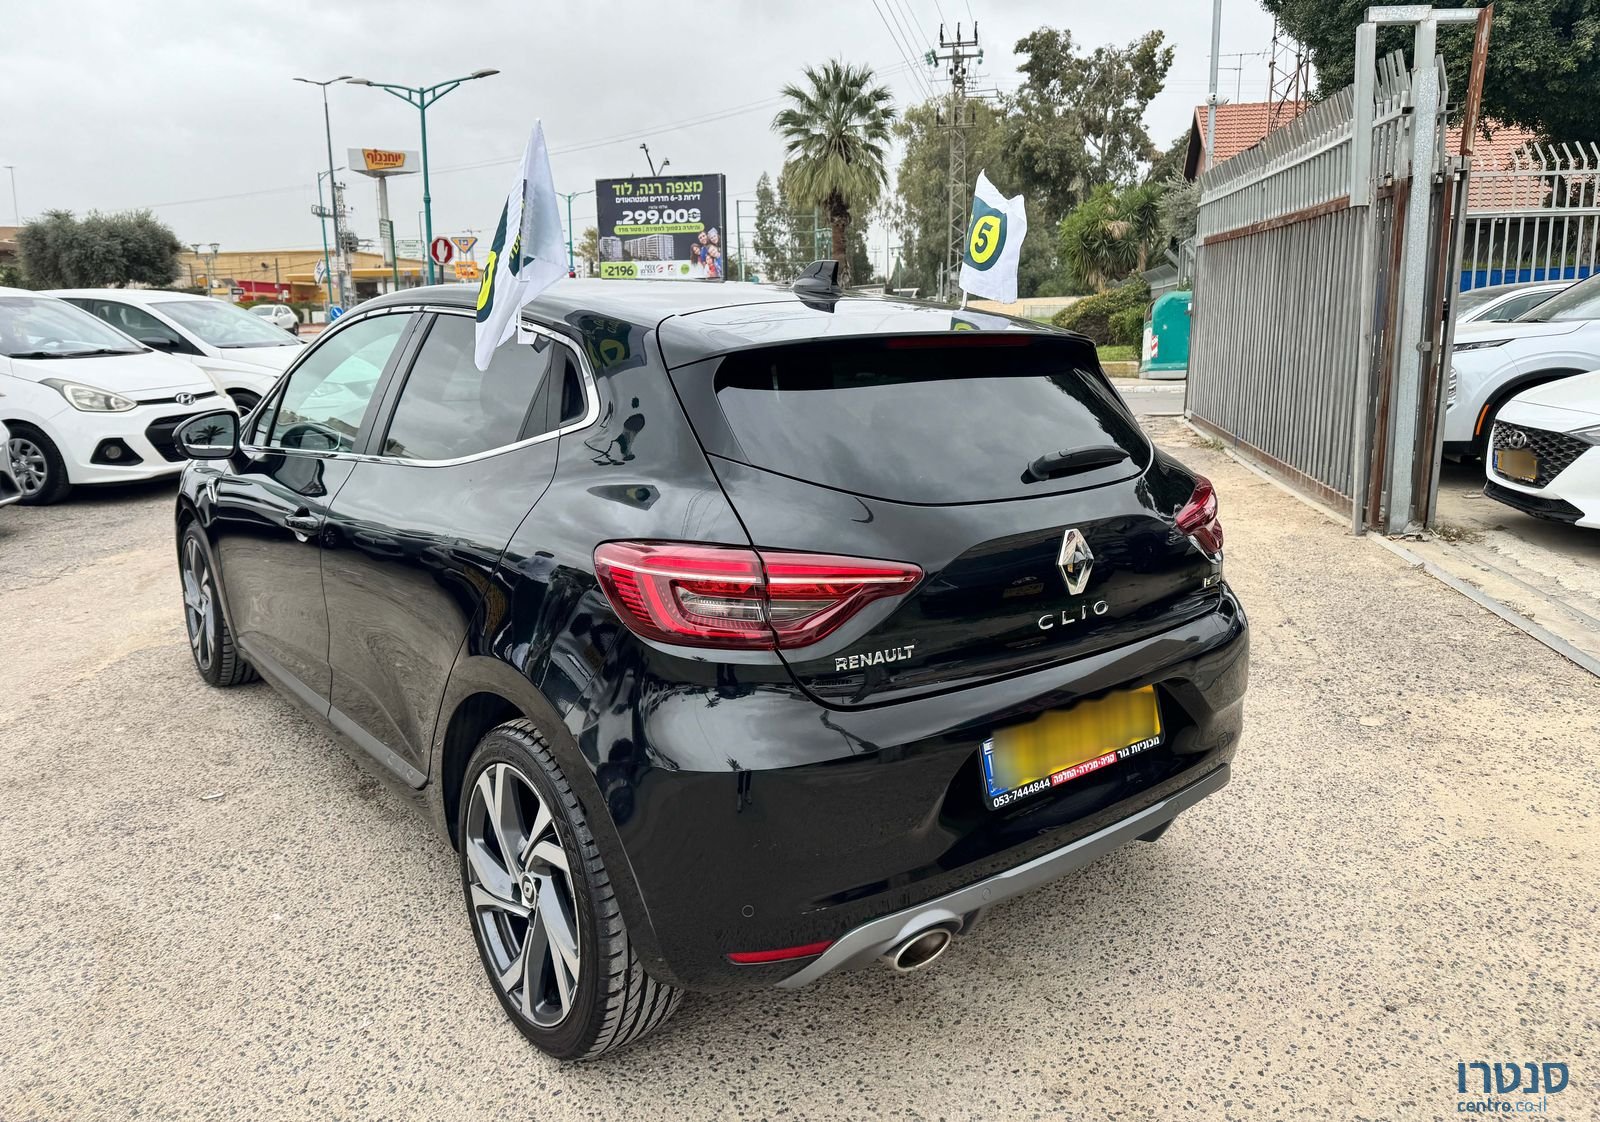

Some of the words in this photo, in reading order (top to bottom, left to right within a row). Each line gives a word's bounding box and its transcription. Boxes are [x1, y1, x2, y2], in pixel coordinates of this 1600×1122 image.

[612, 182, 633, 196] לוד
[636, 183, 662, 196] רנה,
[666, 181, 703, 194] מצפה
[974, 221, 994, 254] 5
[1038, 599, 1110, 631] CLIO
[835, 644, 916, 672] RENAULT
[1117, 748, 1130, 759] גור
[1131, 736, 1160, 754] מכוניות
[993, 777, 1051, 808] 053-7444844
